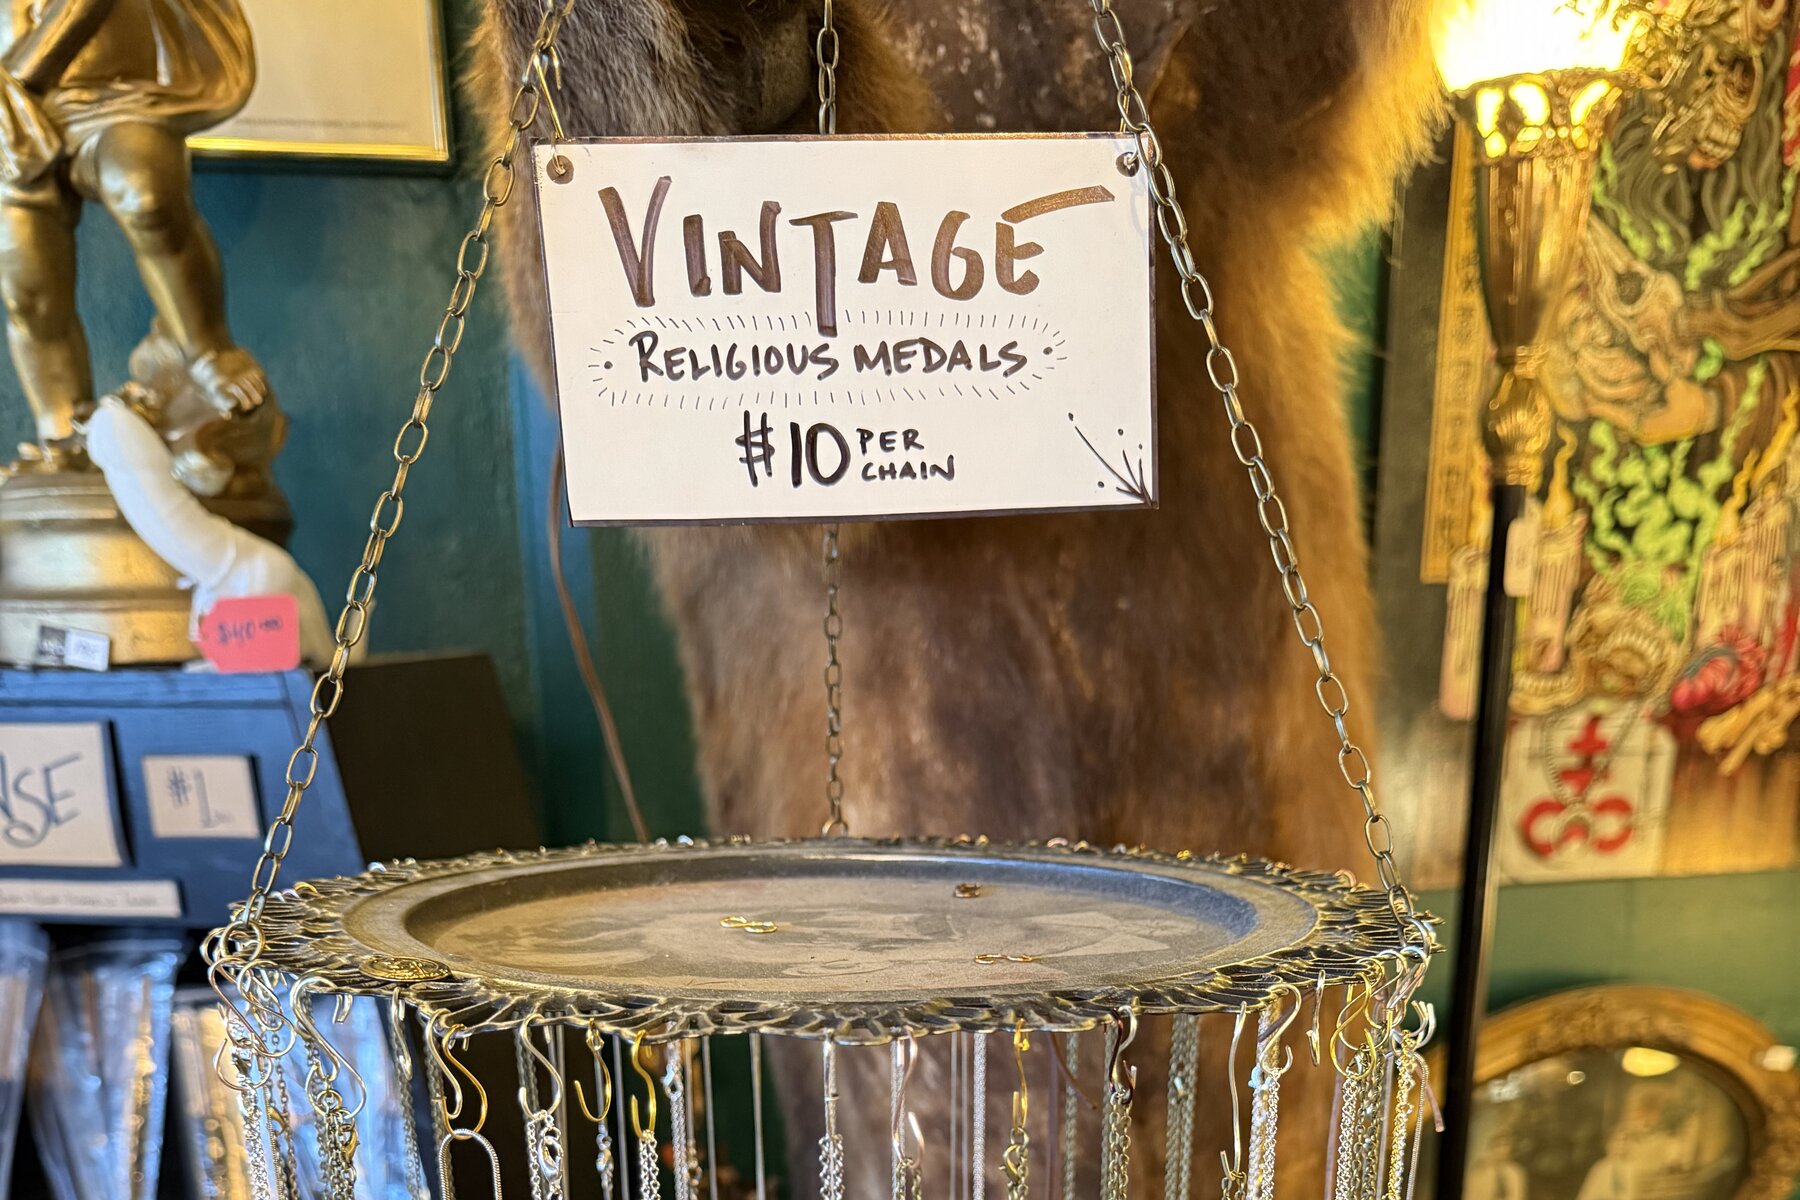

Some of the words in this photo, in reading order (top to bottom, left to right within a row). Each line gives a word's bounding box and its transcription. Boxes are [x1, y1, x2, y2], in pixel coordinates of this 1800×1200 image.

[598, 175, 1115, 337] VINTAGE
[629, 330, 838, 382] RELIGIOUS
[854, 339, 1028, 379] MEDALS
[735, 411, 851, 488] $10
[858, 428, 926, 454] PER
[862, 455, 956, 481] CHAIN
